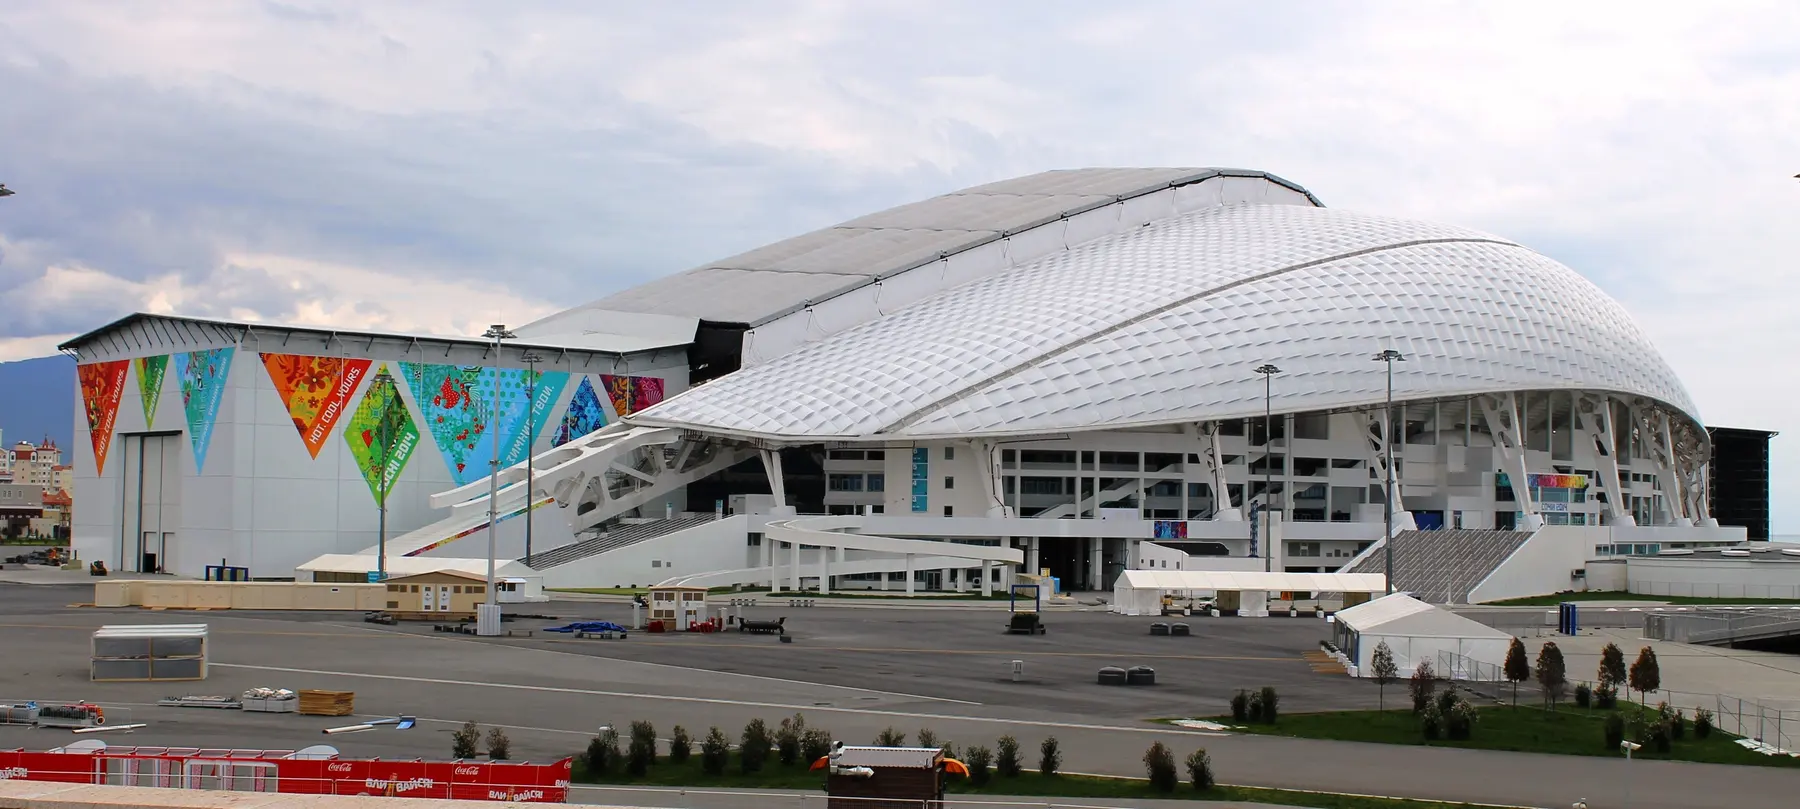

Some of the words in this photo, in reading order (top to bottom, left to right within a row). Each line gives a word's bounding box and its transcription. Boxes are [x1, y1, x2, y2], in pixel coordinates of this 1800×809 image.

[98, 436, 108, 456] HOT.
[104, 407, 115, 433] COOL.
[112, 369, 125, 403] YOURS.
[309, 424, 327, 444] HOT.
[321, 400, 342, 424] COOL.
[336, 367, 361, 397] YOURS.
[506, 418, 537, 465] ЗИМНИЕ.
[531, 385, 555, 416] ТВОИ.
[395, 432, 415, 460] 2014
